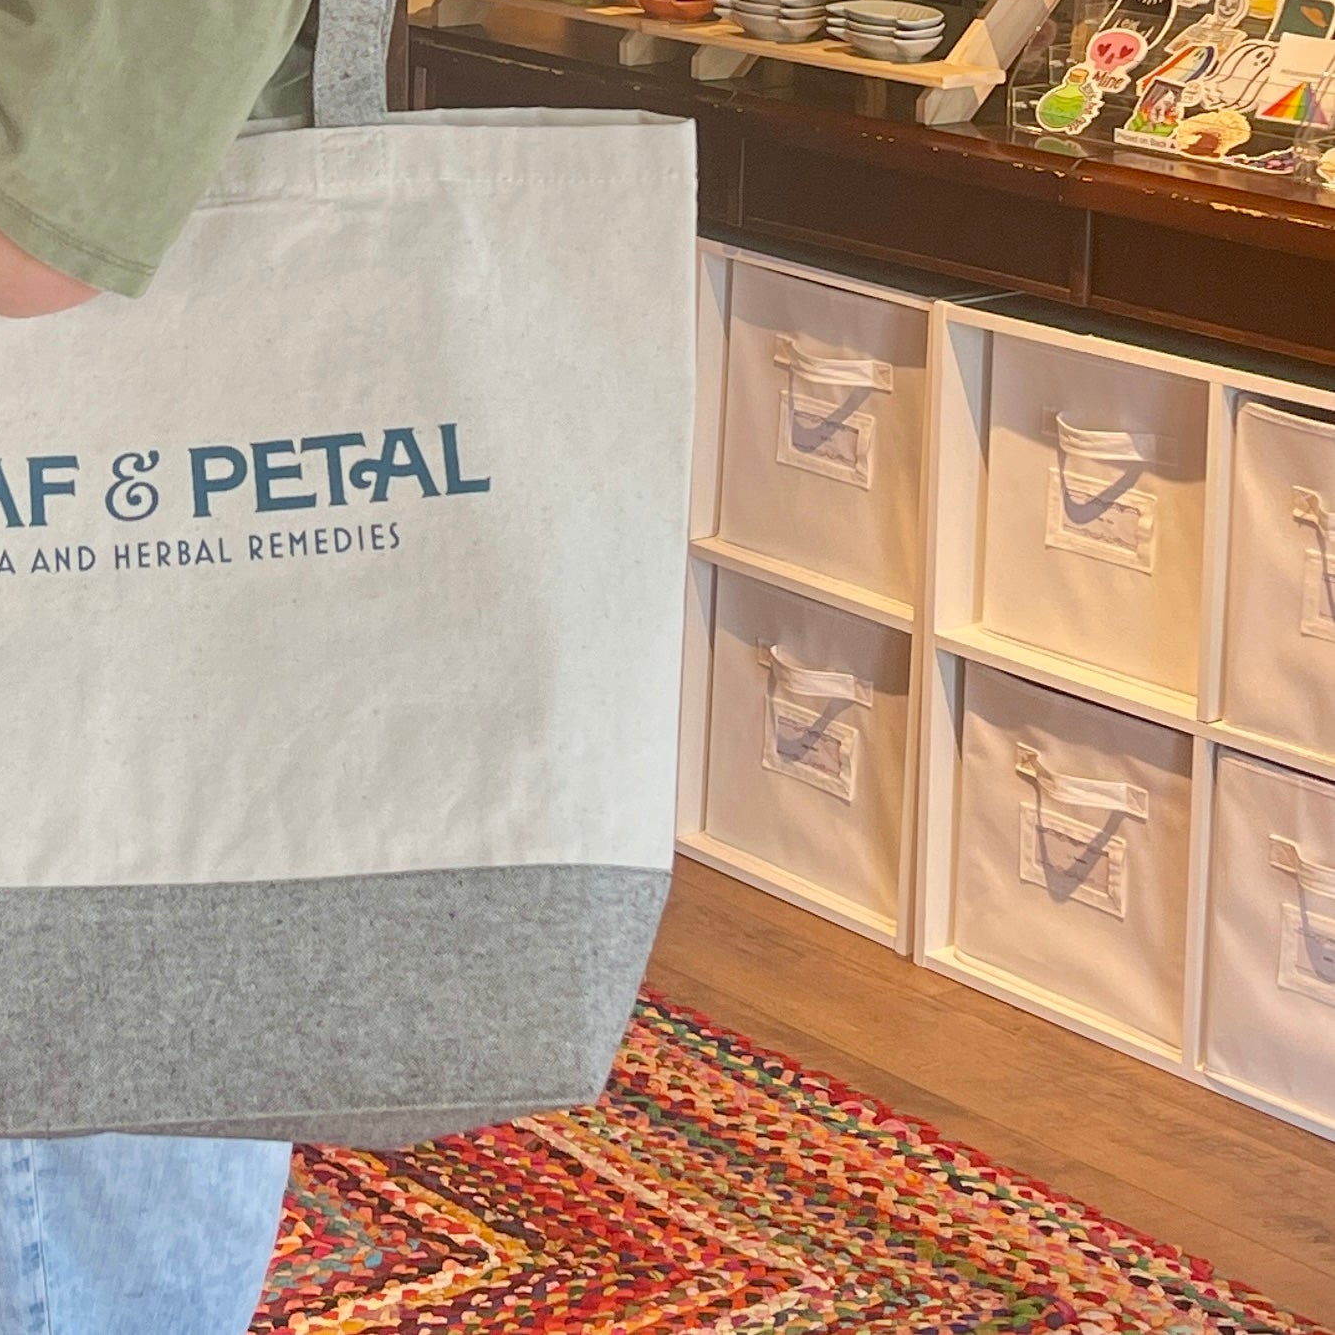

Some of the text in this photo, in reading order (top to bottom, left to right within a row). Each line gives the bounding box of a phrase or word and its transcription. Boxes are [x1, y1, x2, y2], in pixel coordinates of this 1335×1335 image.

[1092, 70, 1126, 91] Mine
[104, 449, 160, 521] &
[188, 422, 492, 518] PETAL
[30, 544, 96, 574] AND
[114, 535, 233, 570] HERBAL
[249, 522, 402, 562] REMEDIES
